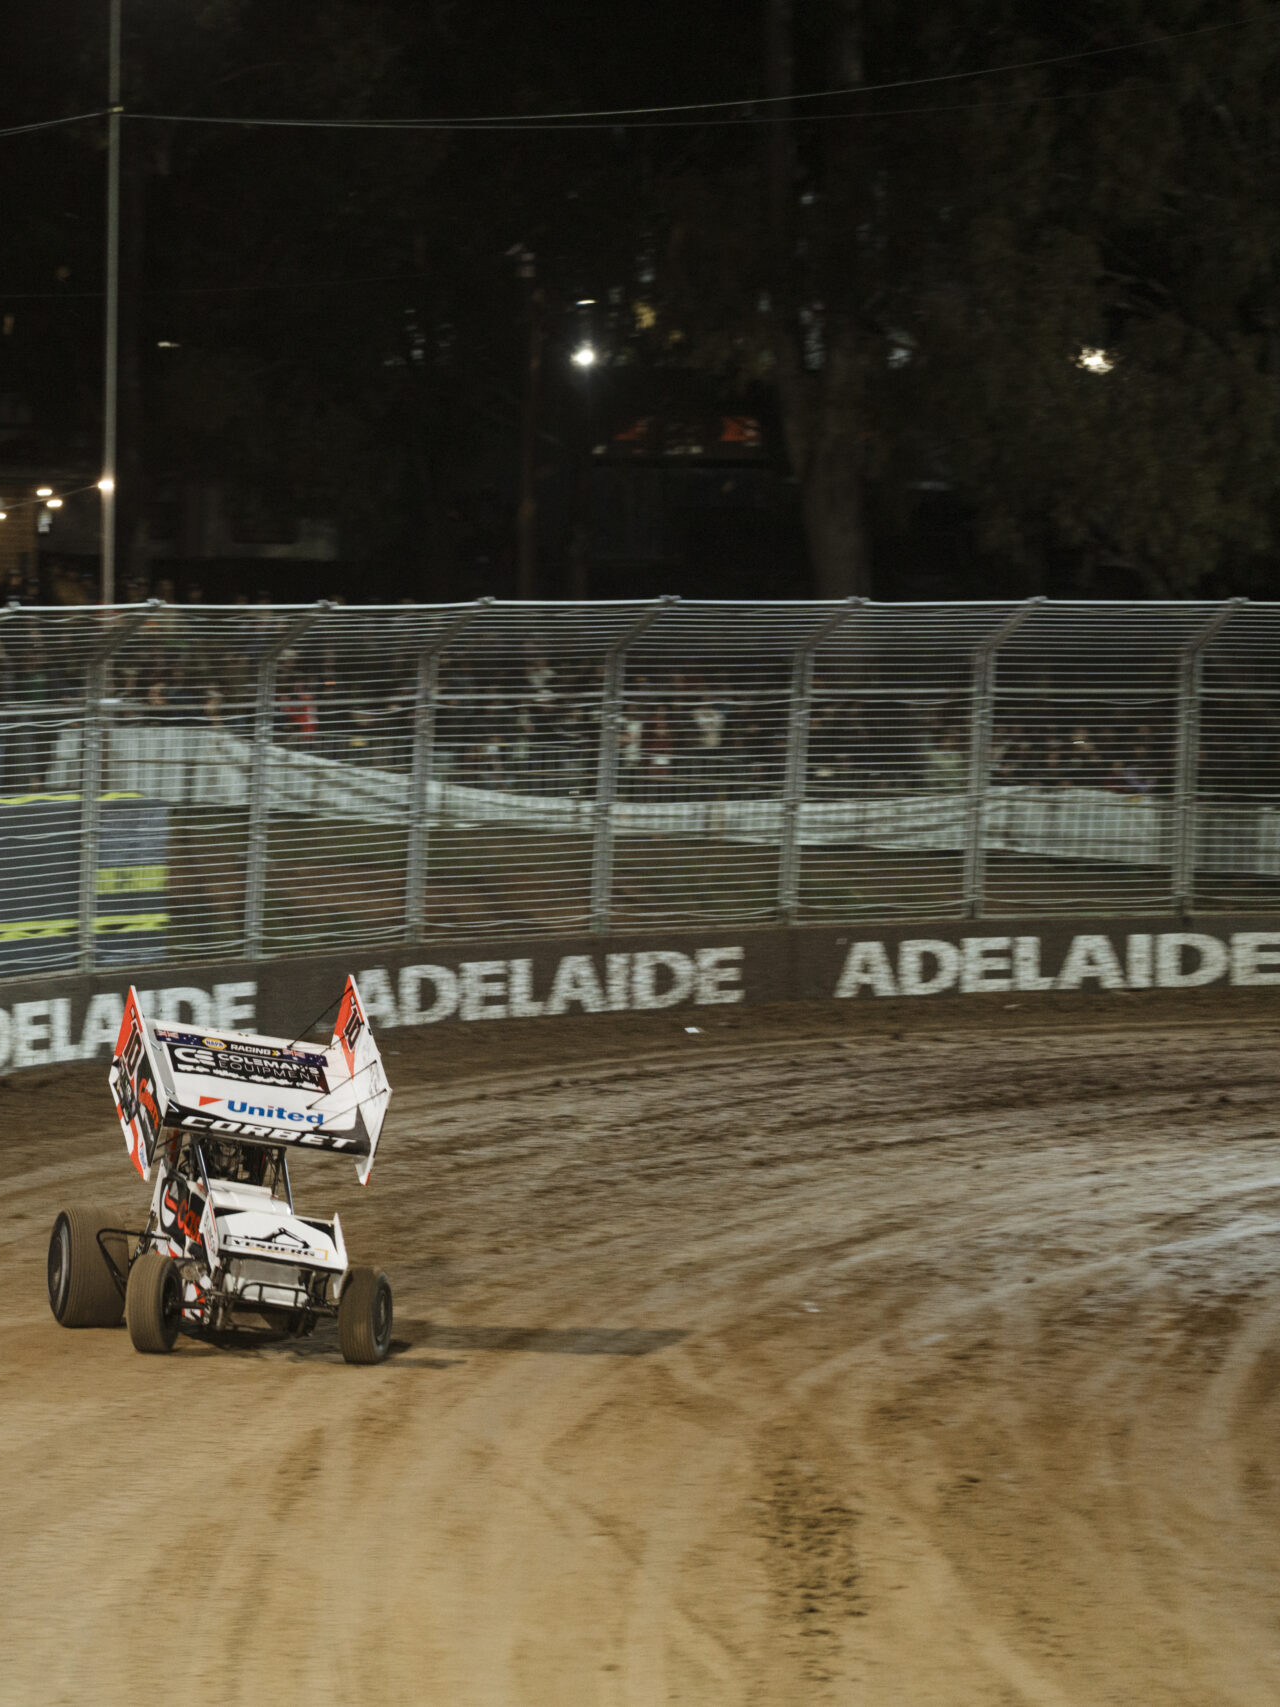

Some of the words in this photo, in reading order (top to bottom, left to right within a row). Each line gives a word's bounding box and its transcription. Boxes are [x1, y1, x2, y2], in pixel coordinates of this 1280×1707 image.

[833, 932, 1280, 998] ADELAIDE
[357, 946, 745, 1029] ADELAIDE
[230, 1043, 272, 1056] RACING
[219, 1060, 320, 1082] EQUIPMENT
[227, 1100, 324, 1125] United
[181, 1116, 357, 1149] CORBET
